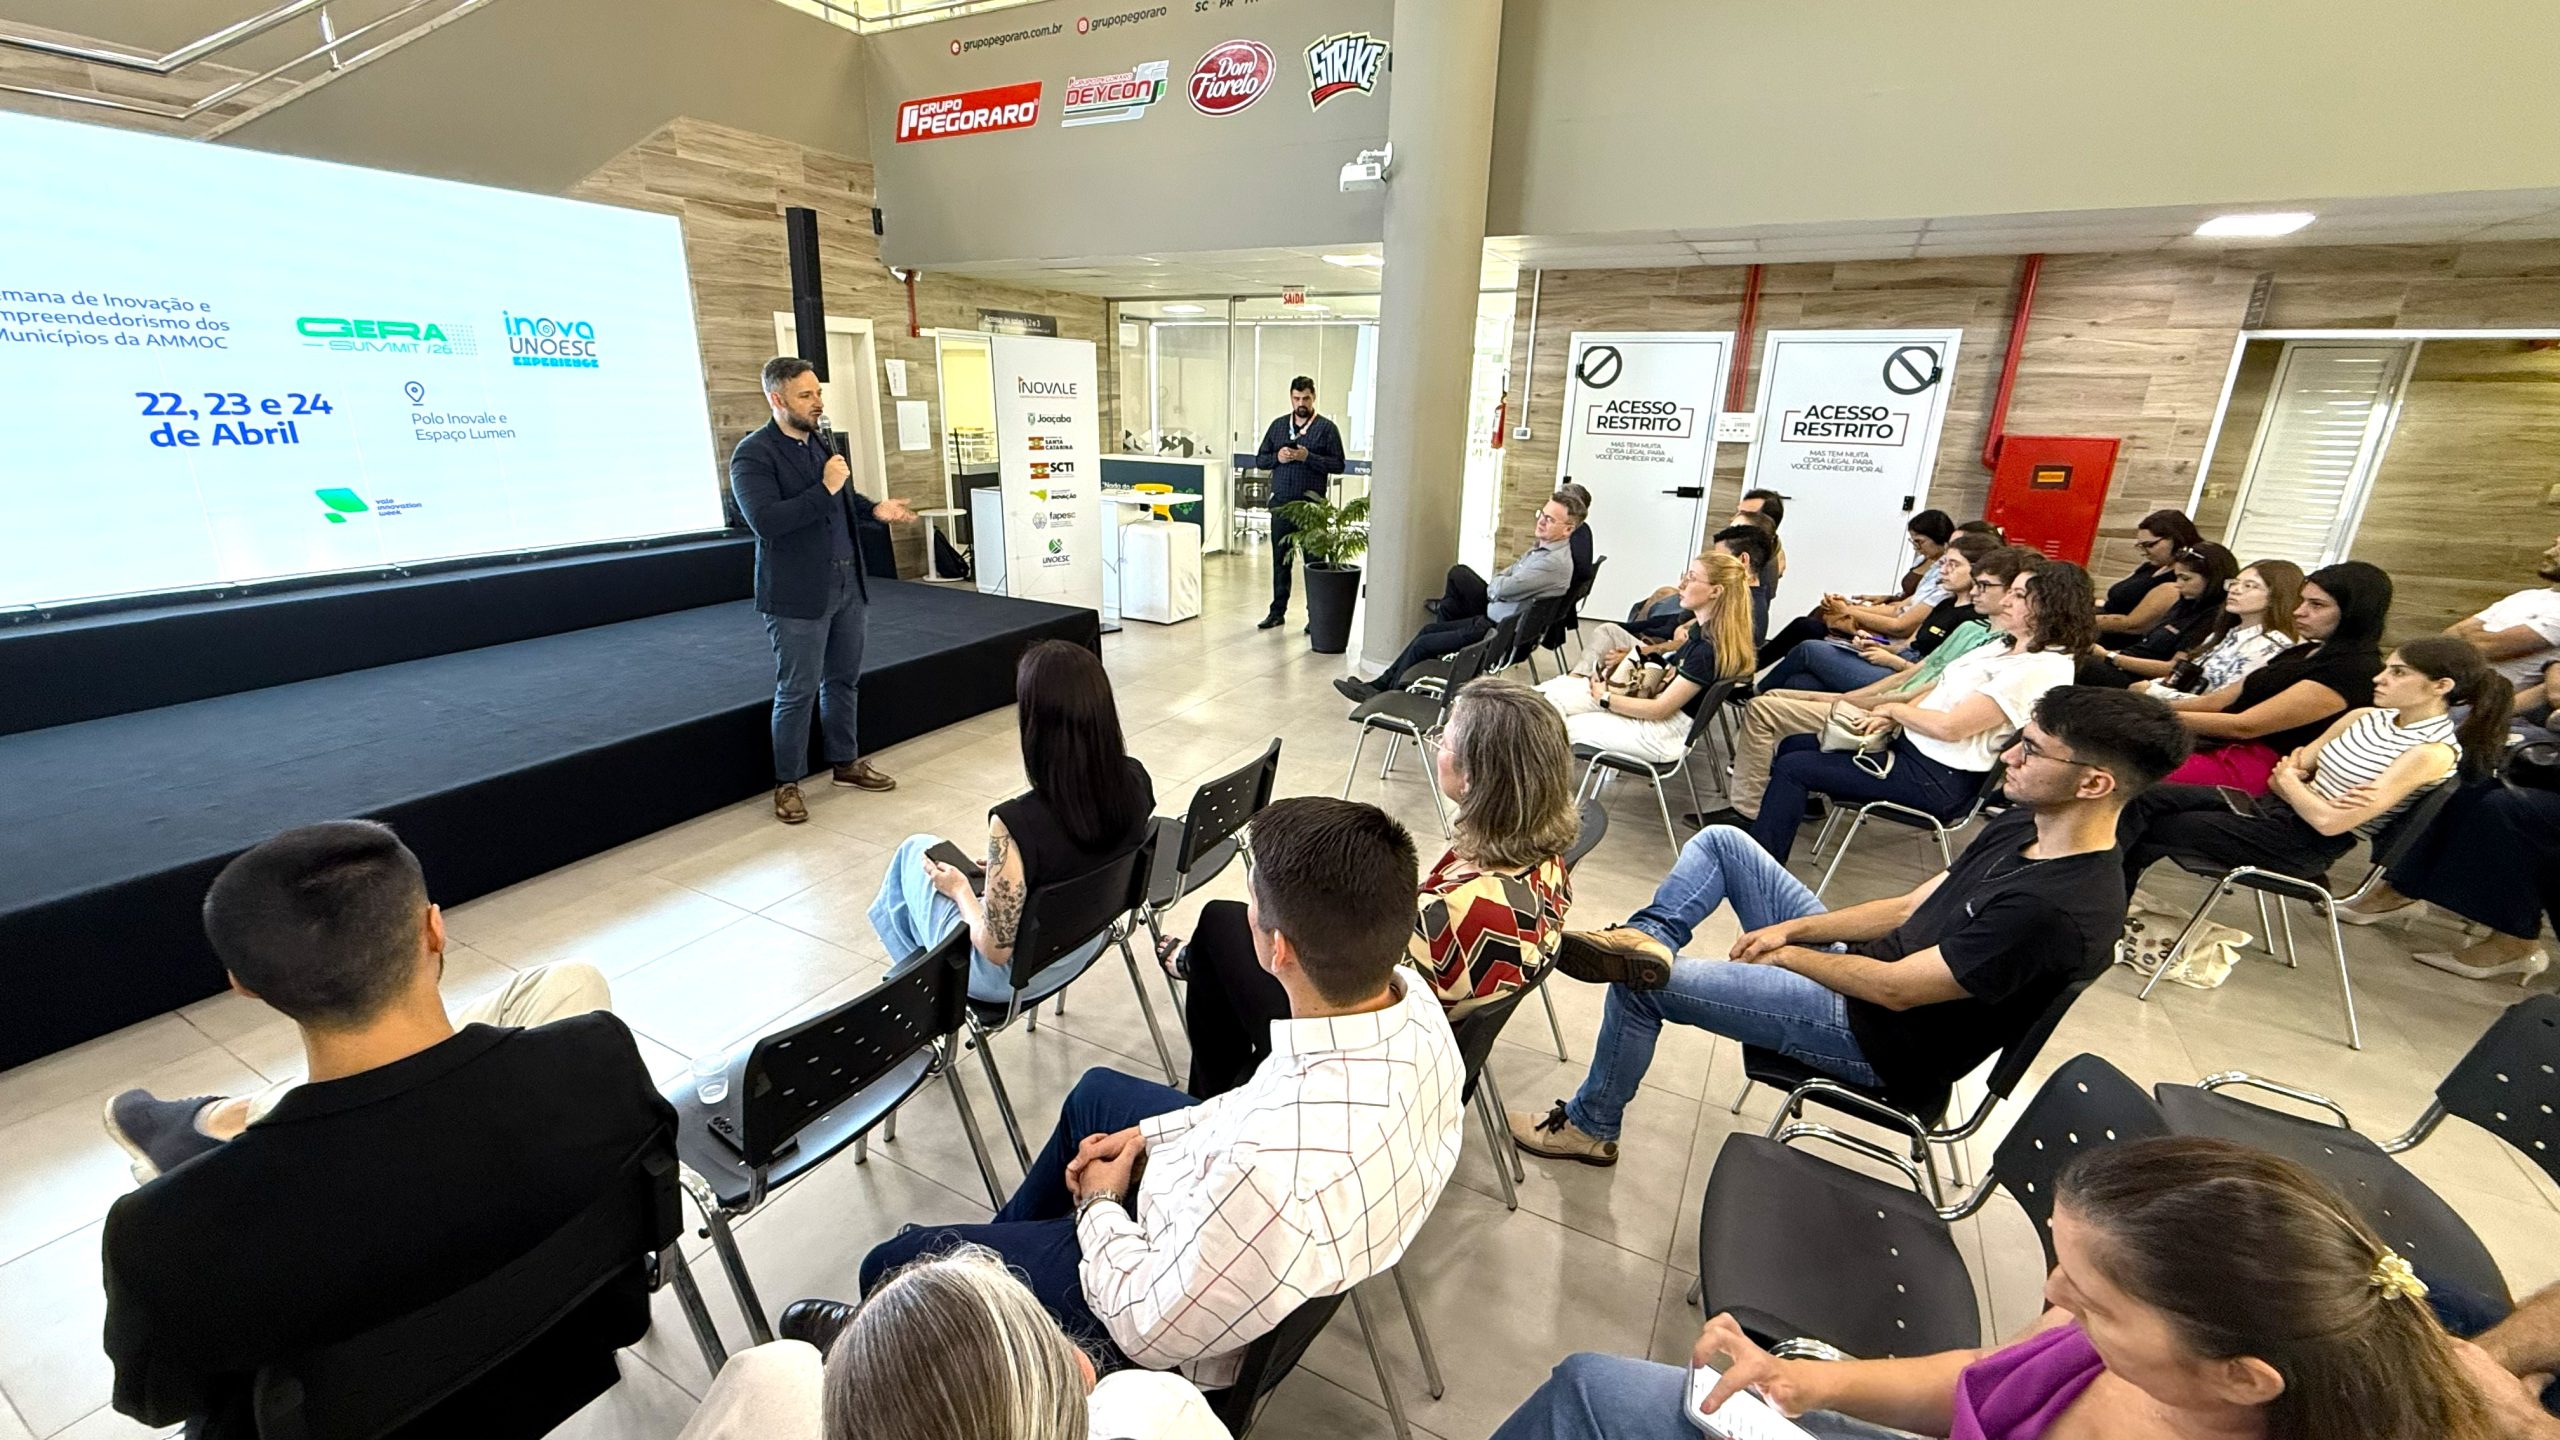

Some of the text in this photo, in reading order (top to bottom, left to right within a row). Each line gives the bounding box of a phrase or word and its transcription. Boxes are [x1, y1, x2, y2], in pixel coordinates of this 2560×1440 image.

[1195, 1, 1209, 13] SC
[1091, 6, 1168, 31] grupopegoraro
[963, 22, 1063, 52] grupopegoraro.com.br
[1218, 57, 1255, 78] Dom
[1066, 80, 1152, 106] DEYCON
[1196, 73, 1259, 100] Fiorelo
[919, 98, 962, 116] GRUPO
[917, 103, 1035, 135] PEGORARO
[0, 290, 211, 313] mana de Inovação e
[196, 317, 231, 331] dos
[297, 316, 448, 342] GERA
[115, 332, 140, 346] da
[146, 334, 229, 350] AMMOC
[329, 340, 420, 354] SUMMIT
[509, 337, 596, 357] UNOESC
[513, 356, 599, 368] EXPERIENCE
[1018, 376, 1077, 394] INOVALE
[135, 391, 333, 420] 22, 23 e 24
[1605, 400, 1677, 415] ACESSO
[1804, 405, 1889, 421] ACESSO
[412, 411, 507, 425] Polo Inovale e
[1037, 413, 1072, 425] Joaçaba
[1597, 415, 1681, 432] RESTRITO
[149, 420, 300, 447] de Abril
[415, 427, 516, 443] Espaço Lumen
[1793, 421, 1893, 439] RESTRITO
[1614, 454, 1650, 462] CONHECER
[1050, 462, 1074, 472] SCTI
[1791, 462, 1811, 470] VOCÊ
[1812, 464, 1855, 472] CONHECER
[1049, 511, 1076, 520] fapesc
[1042, 555, 1070, 563] UNOESC
